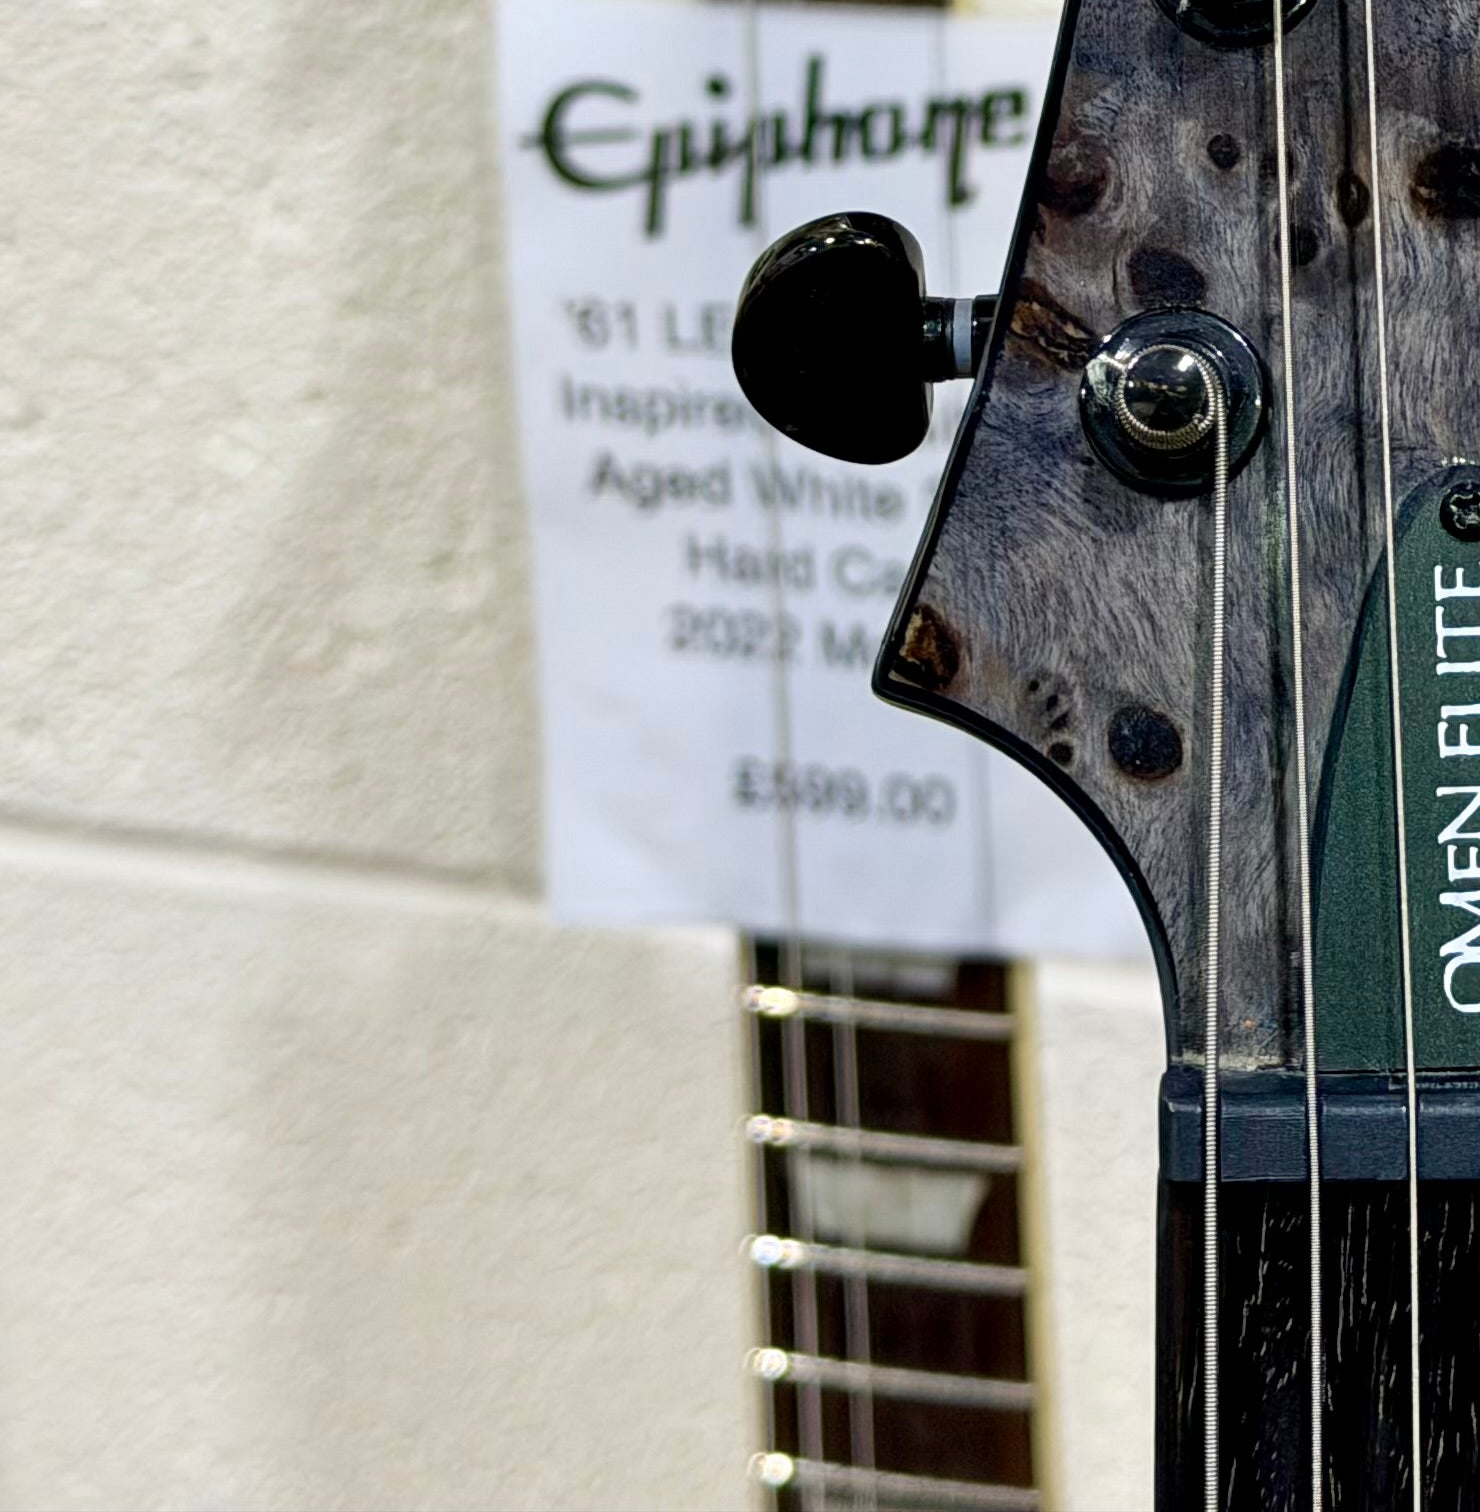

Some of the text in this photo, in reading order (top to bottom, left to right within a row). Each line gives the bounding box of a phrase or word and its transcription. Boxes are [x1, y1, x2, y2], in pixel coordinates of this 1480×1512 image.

[522, 51, 1030, 236] Epiphone
[663, 300, 737, 356] LE
[559, 372, 762, 436] Inspire
[590, 455, 732, 516] Aged
[748, 460, 906, 520] White
